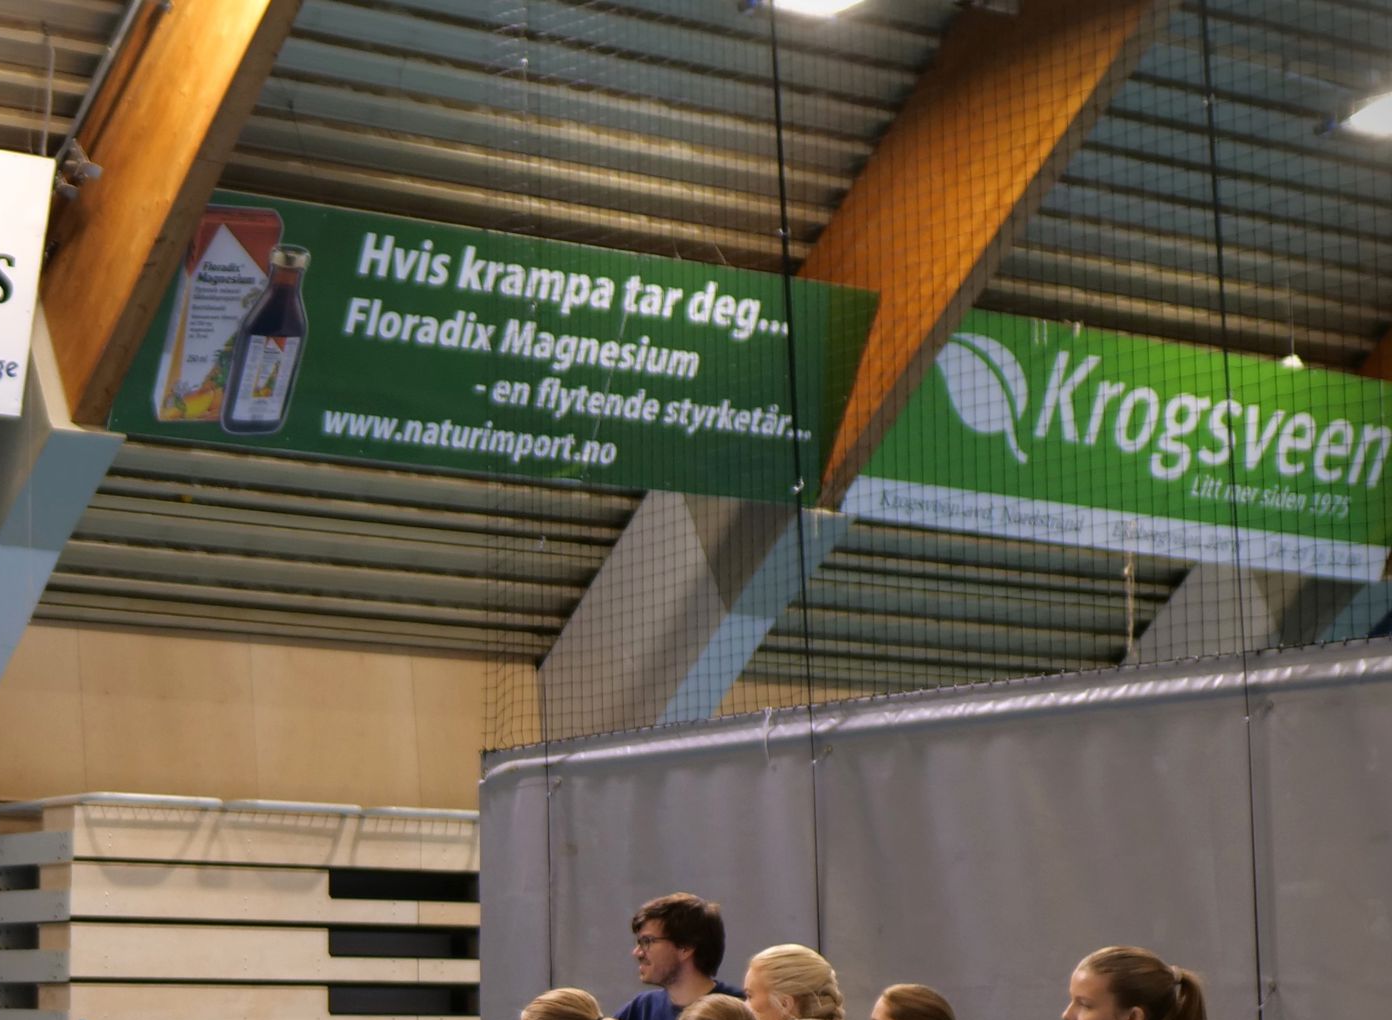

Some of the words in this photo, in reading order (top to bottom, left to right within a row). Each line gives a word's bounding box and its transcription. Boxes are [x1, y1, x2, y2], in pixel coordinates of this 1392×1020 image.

[358, 232, 450, 286] Hvis
[456, 246, 617, 312] krampa
[620, 274, 682, 322] tar
[684, 281, 789, 338] deg...
[344, 297, 495, 351] Floradix
[499, 318, 700, 379] Magnesium
[323, 407, 618, 466] www.naturimport.no
[492, 379, 531, 406] en
[535, 376, 660, 420] flytende
[1034, 349, 1392, 487] Krogsveen
